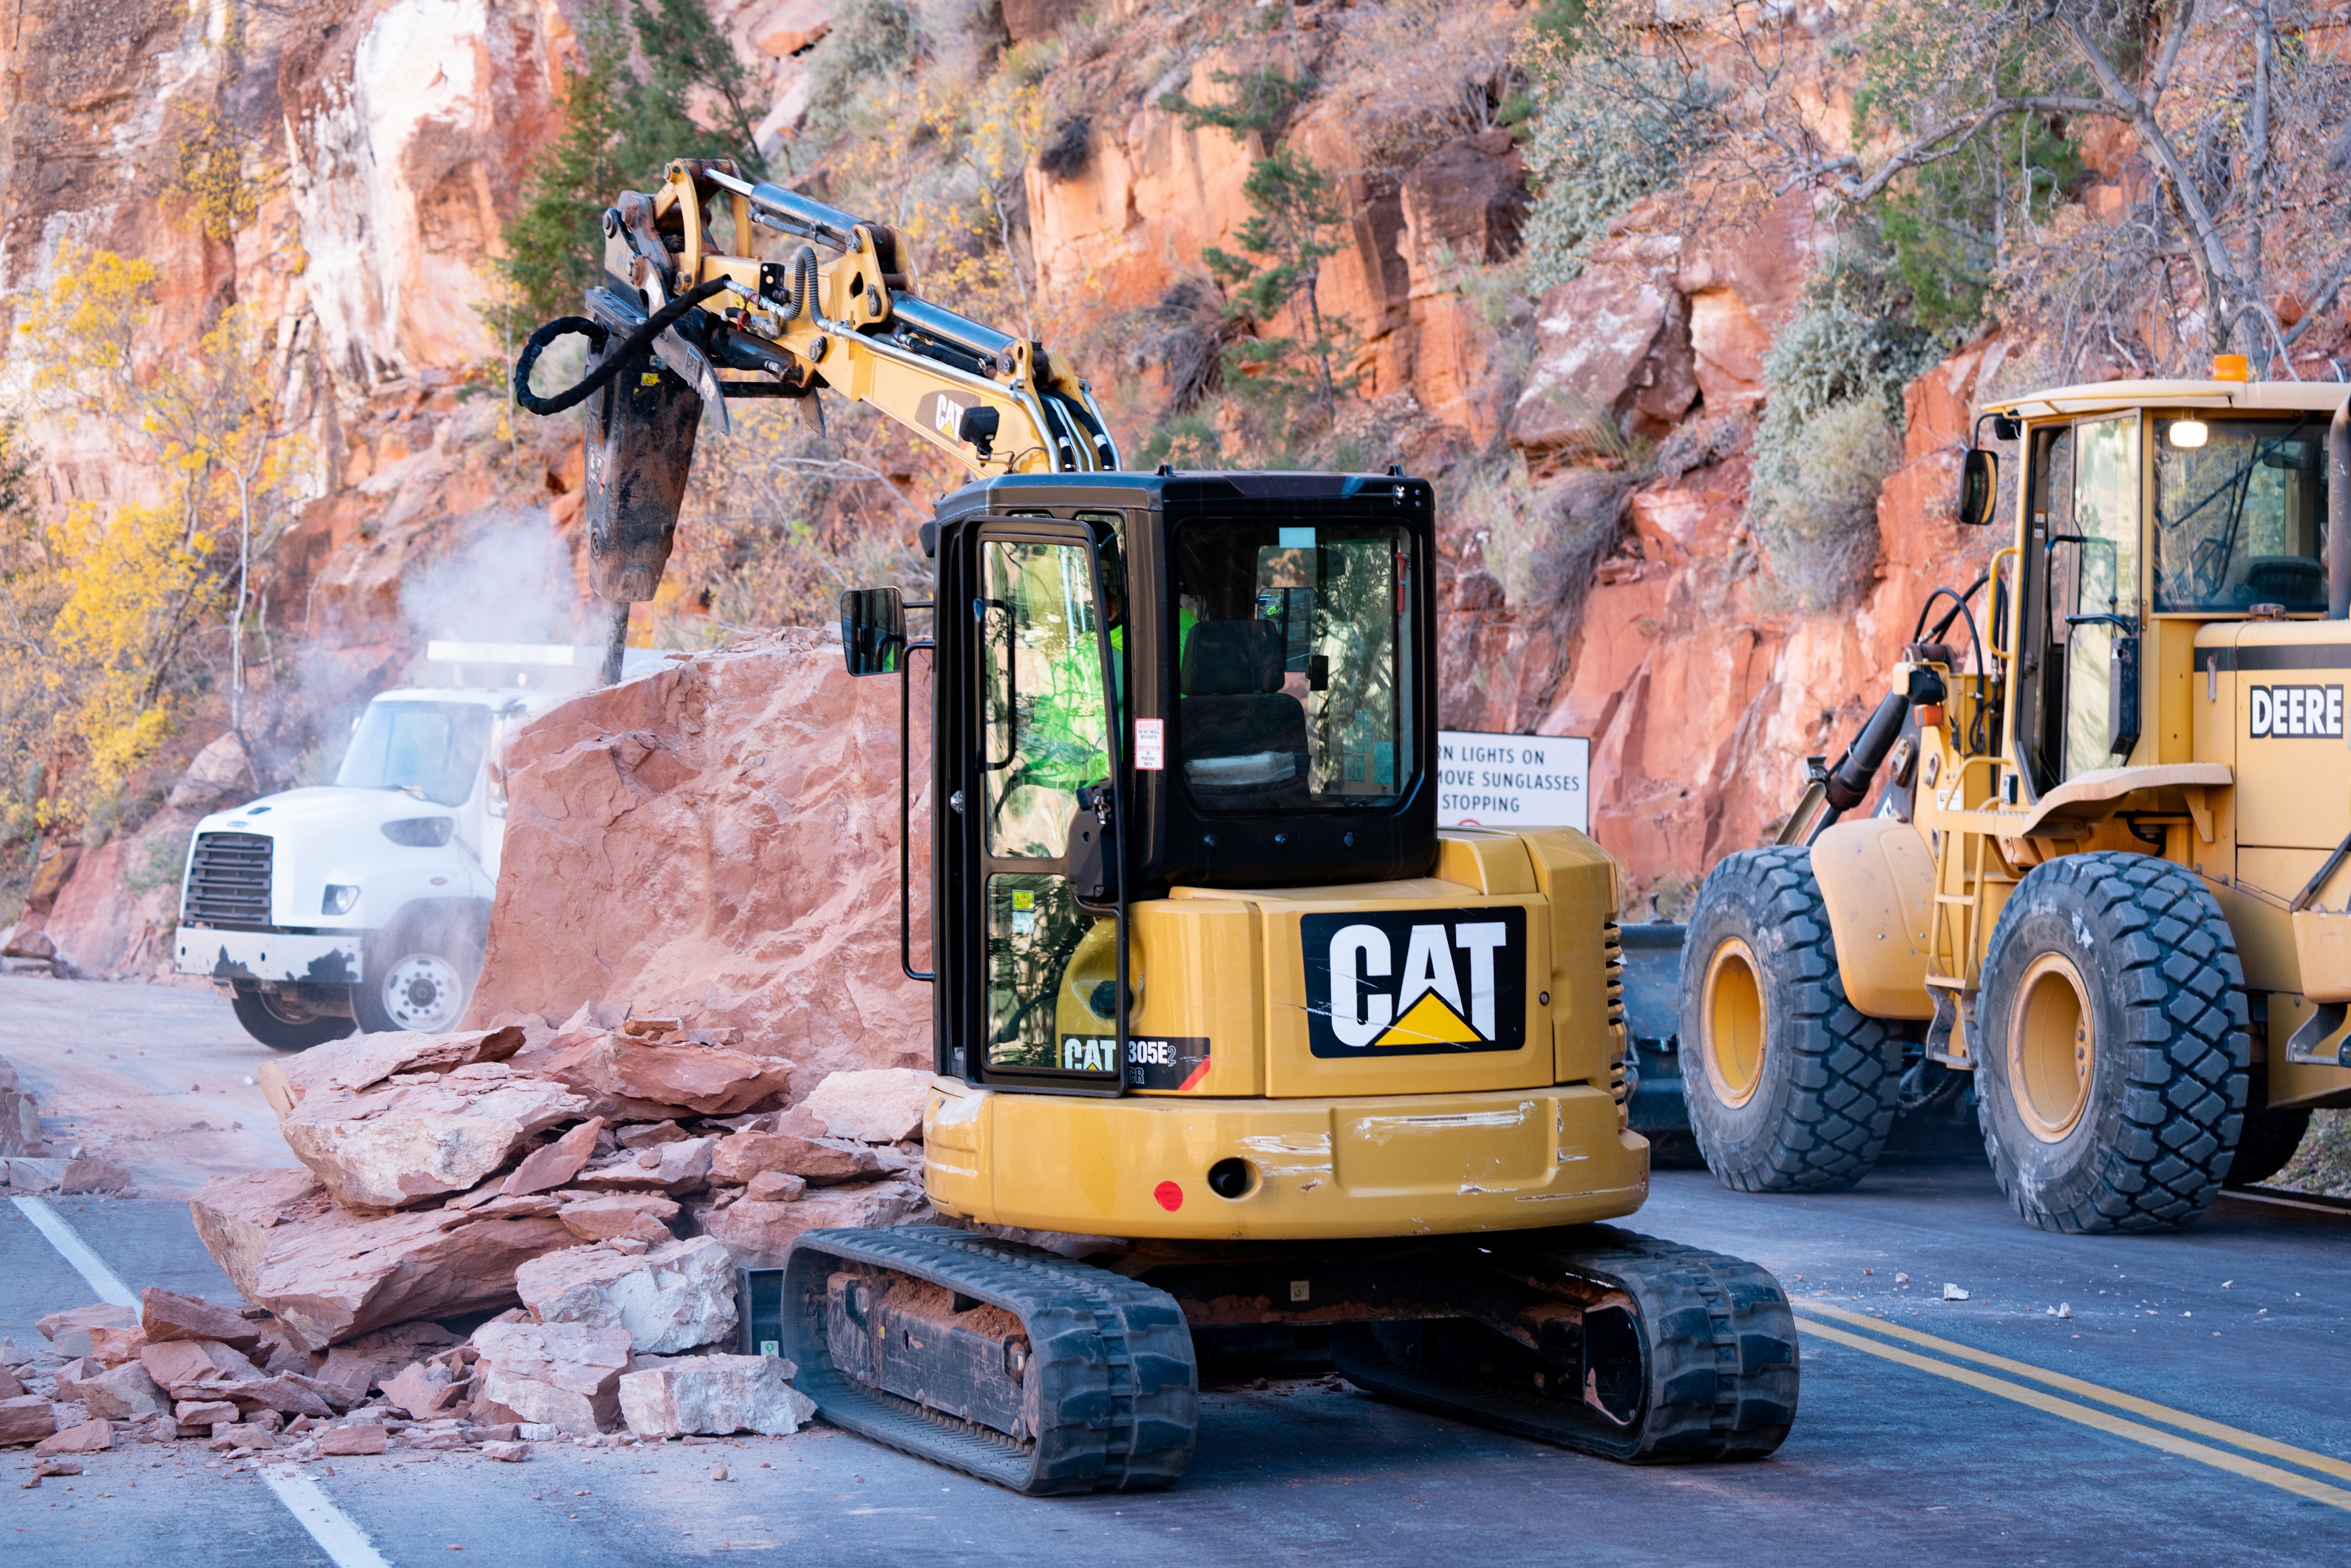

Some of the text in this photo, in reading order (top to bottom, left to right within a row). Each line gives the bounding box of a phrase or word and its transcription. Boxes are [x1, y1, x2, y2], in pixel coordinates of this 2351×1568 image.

[935, 394, 964, 443] CAT
[2251, 688, 2343, 735] DEERE
[1462, 746, 1514, 763] LIGHTS
[1522, 749, 1545, 765] ON
[1482, 771, 1580, 791] SUNGLASSES
[1442, 794, 1520, 813] STOPPING
[1330, 921, 1506, 1047] CAT
[1064, 1038, 1117, 1071] CAT
